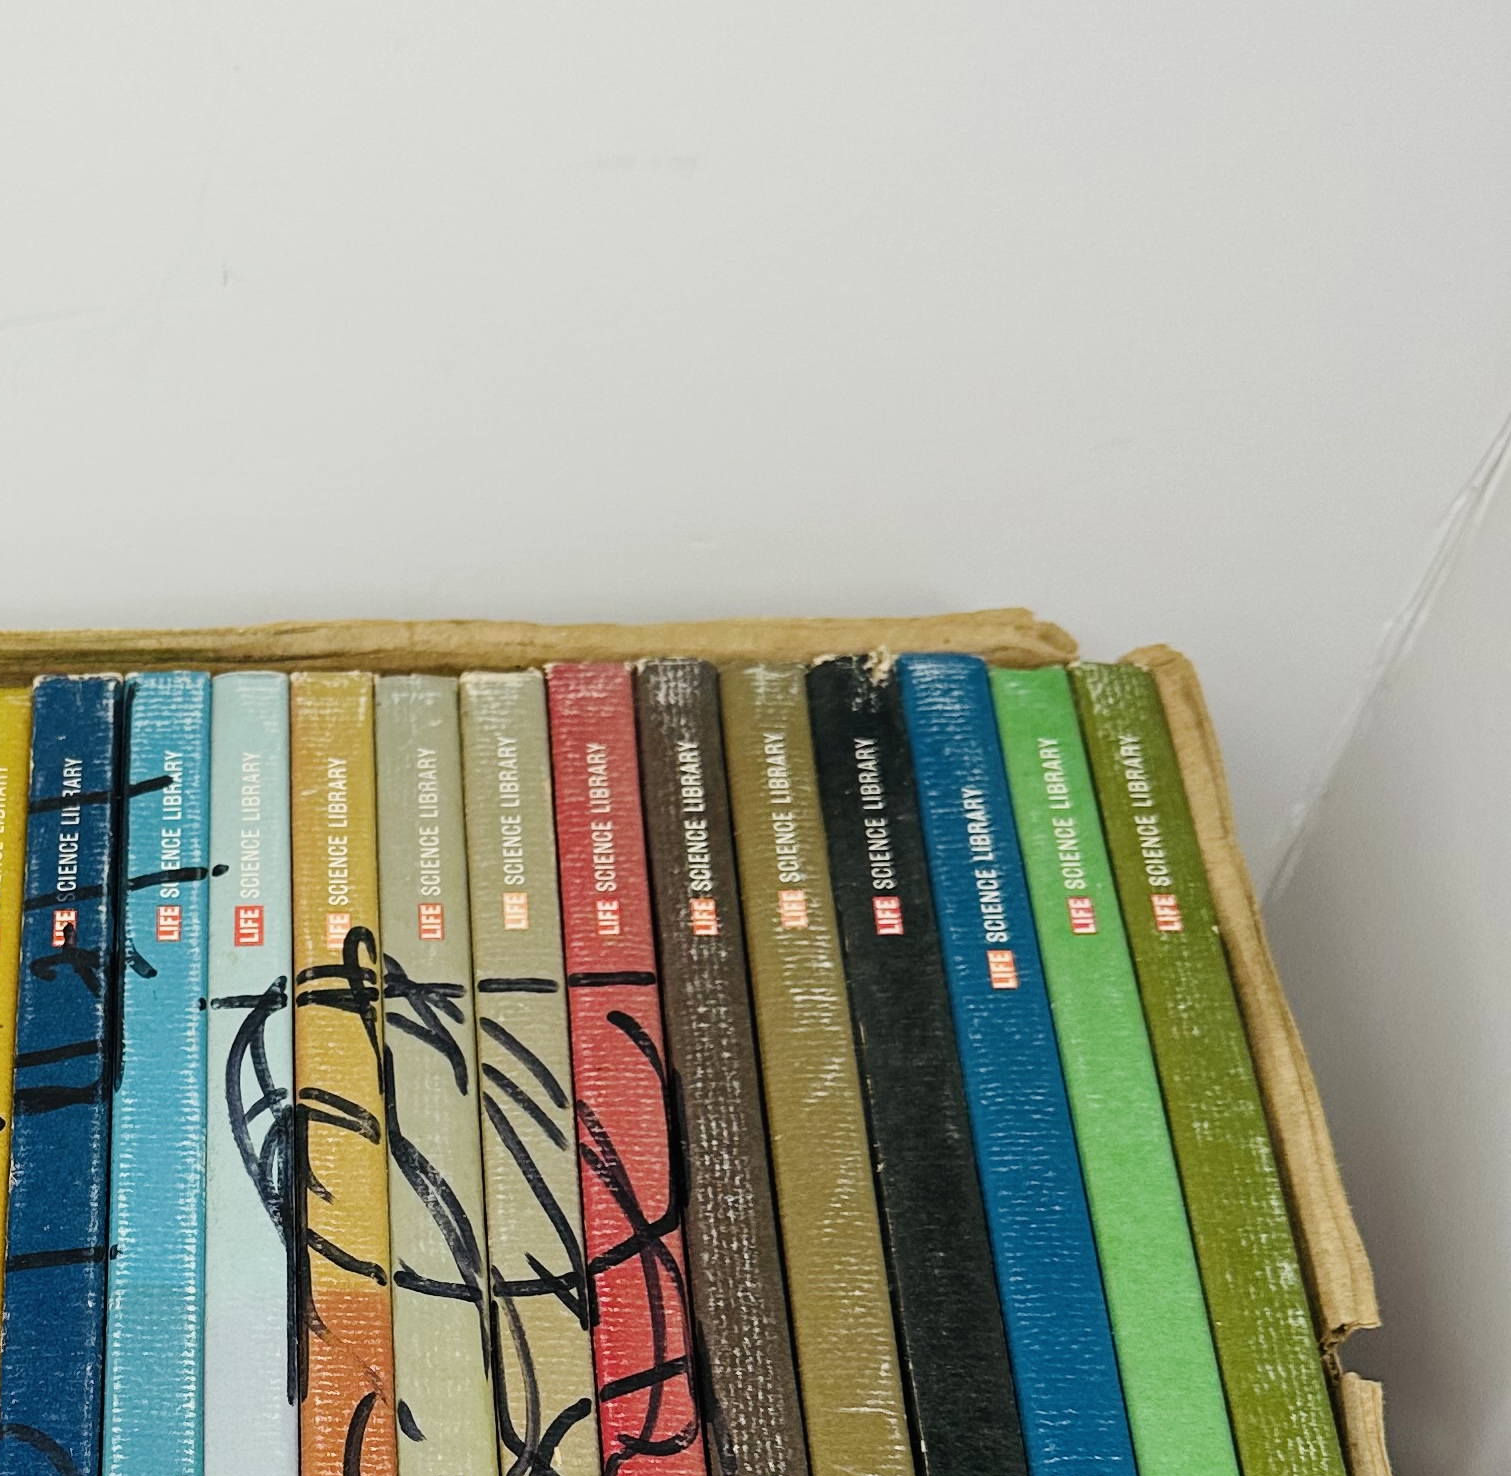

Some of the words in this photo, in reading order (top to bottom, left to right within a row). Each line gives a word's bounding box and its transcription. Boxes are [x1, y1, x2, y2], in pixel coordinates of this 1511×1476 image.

[242, 751, 262, 821] LIBRARY
[328, 757, 348, 828] LIBRARY
[418, 748, 439, 818] LIBRARY
[498, 733, 520, 806] LIBRARY
[588, 743, 610, 814] LIBRARY
[677, 740, 706, 813] LIBRARY
[763, 733, 793, 805] LIBRARY
[854, 737, 885, 812] LIBRARY
[1038, 738, 1071, 809] LIBRARY
[1120, 735, 1153, 808] LIBRARY
[420, 824, 441, 897] SCIENCE
[501, 812, 525, 885] SCIENCE
[593, 820, 618, 892] SCIENCE
[684, 820, 713, 892] SCIENCE
[771, 811, 800, 884] SCIENCE
[865, 818, 896, 890] SCIENCE
[962, 788, 994, 862] LIBRARY
[1053, 817, 1086, 890] SCIENCE
[1136, 815, 1170, 888] SCIENCE
[240, 826, 261, 898] SCIENCE
[328, 835, 349, 905] SCIENCE
[156, 905, 182, 942] LIFE
[234, 905, 264, 946] LIFE
[419, 904, 444, 940] LIFE
[503, 892, 528, 930] LIFE
[597, 900, 621, 935] LIFE
[691, 898, 719, 935] LIFE
[778, 890, 808, 928] LIFE
[873, 897, 903, 935] LIFE
[976, 868, 1007, 943] SCIENCE
[1067, 897, 1097, 934] LIFE
[1151, 894, 1183, 931] LIFE
[987, 950, 1018, 989] LIFE
